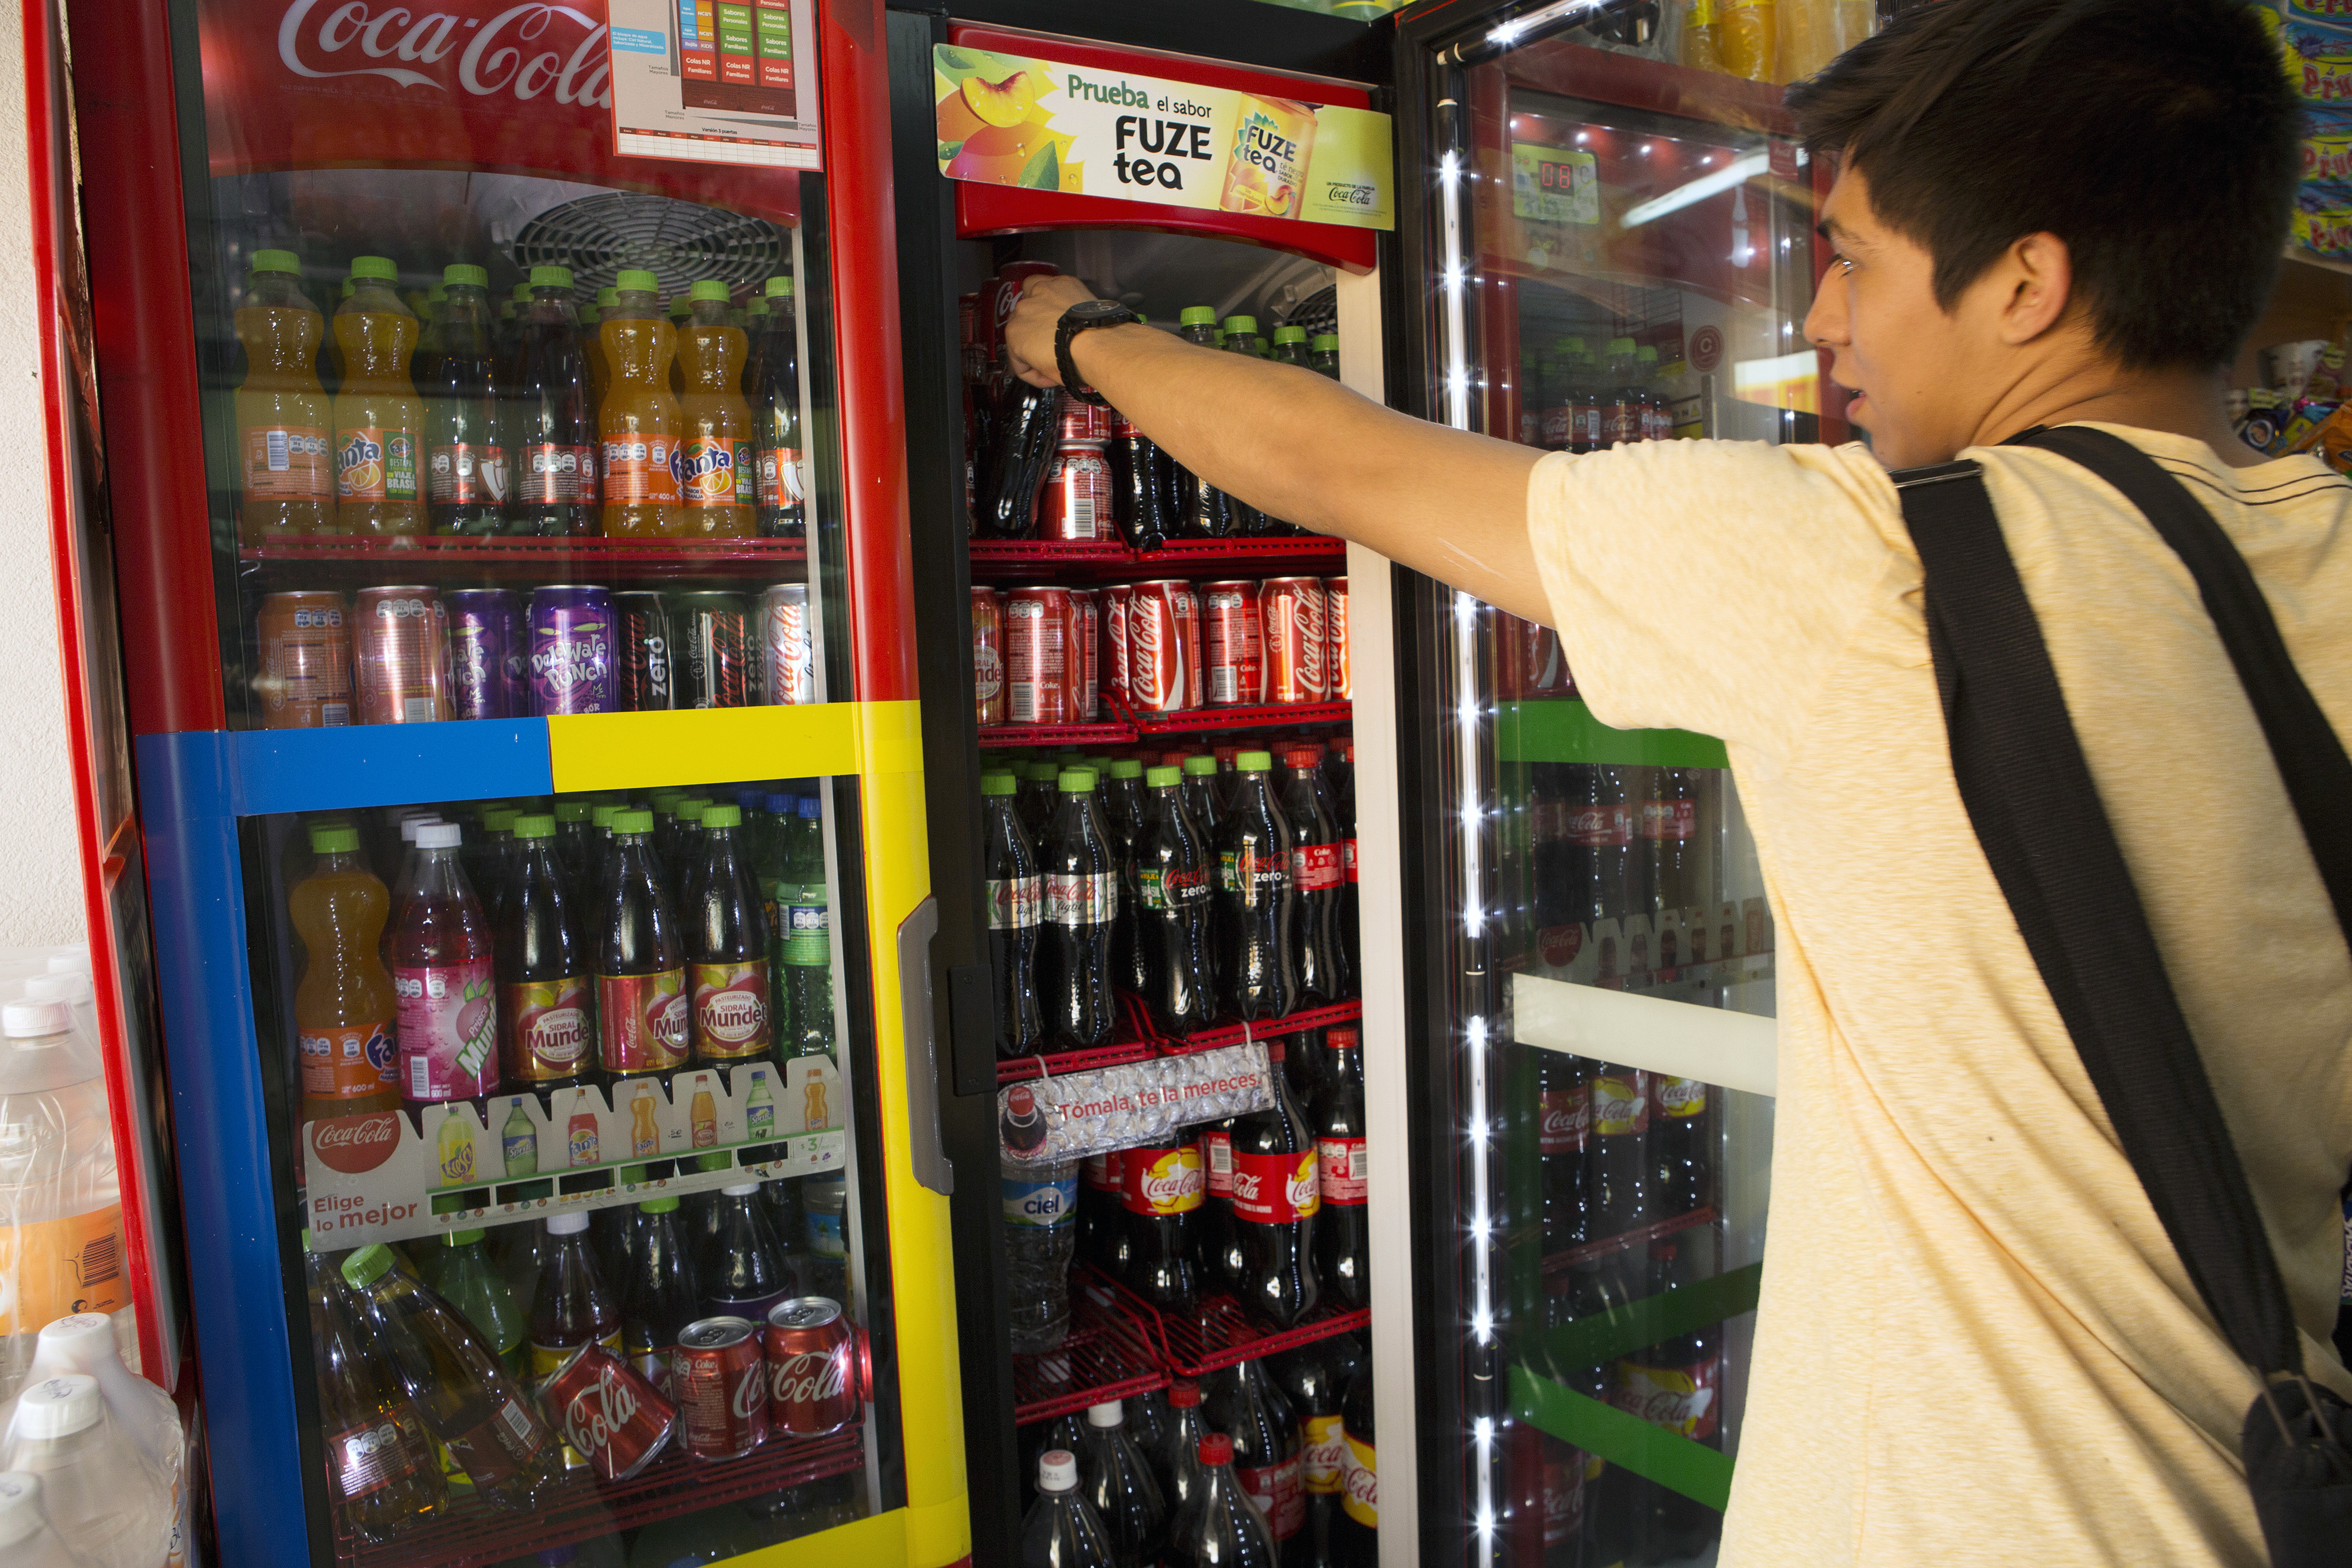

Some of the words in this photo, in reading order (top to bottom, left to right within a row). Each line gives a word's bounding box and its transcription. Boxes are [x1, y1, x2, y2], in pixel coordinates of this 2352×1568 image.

[278, 0, 612, 109] Coca-Cola
[1068, 74, 1150, 109] Prueba
[1157, 98, 1171, 113] el
[1174, 99, 1212, 118] sabor
[1115, 115, 1213, 161] FUZE
[1247, 125, 1297, 162] FUZE
[1113, 149, 1184, 190] tea
[1243, 143, 1276, 173] tea
[1279, 162, 1288, 170] té
[1542, 163, 1570, 188] 08
[1329, 186, 1371, 205] Coca-Cola
[387, 478, 416, 490] BRASIL
[1129, 590, 1161, 705] Coca-Cola
[1293, 582, 1325, 693] Coca-Cola
[649, 636, 667, 696] zero
[747, 635, 757, 693] zero
[1240, 851, 1289, 872] Coca-Cola
[1314, 848, 1331, 857] Coke
[1254, 871, 1282, 882] zero
[1181, 885, 1206, 898] zero
[1057, 901, 1083, 914] light
[714, 994, 751, 1004] PASTEURIZADO
[720, 1003, 747, 1012] SIDRAL
[468, 1004, 489, 1037] Prisco
[549, 1021, 576, 1032] SIDRAL
[700, 1002, 767, 1028] Mundet
[526, 1022, 589, 1049] Munde
[1058, 1094, 1136, 1121] Tómala,
[1139, 1092, 1157, 1106] te
[1160, 1086, 1179, 1104] la
[1184, 1073, 1262, 1100] mereces.
[751, 1114, 770, 1125] Sprite
[316, 1117, 396, 1149] Coca-Cola
[569, 1135, 598, 1158] Fanta
[635, 1140, 654, 1152] Fanta
[314, 1194, 365, 1214] Elige
[1024, 1193, 1060, 1214] ciel
[316, 1218, 333, 1232] lo
[339, 1201, 417, 1229] mejor
[695, 1359, 716, 1369] Coke
